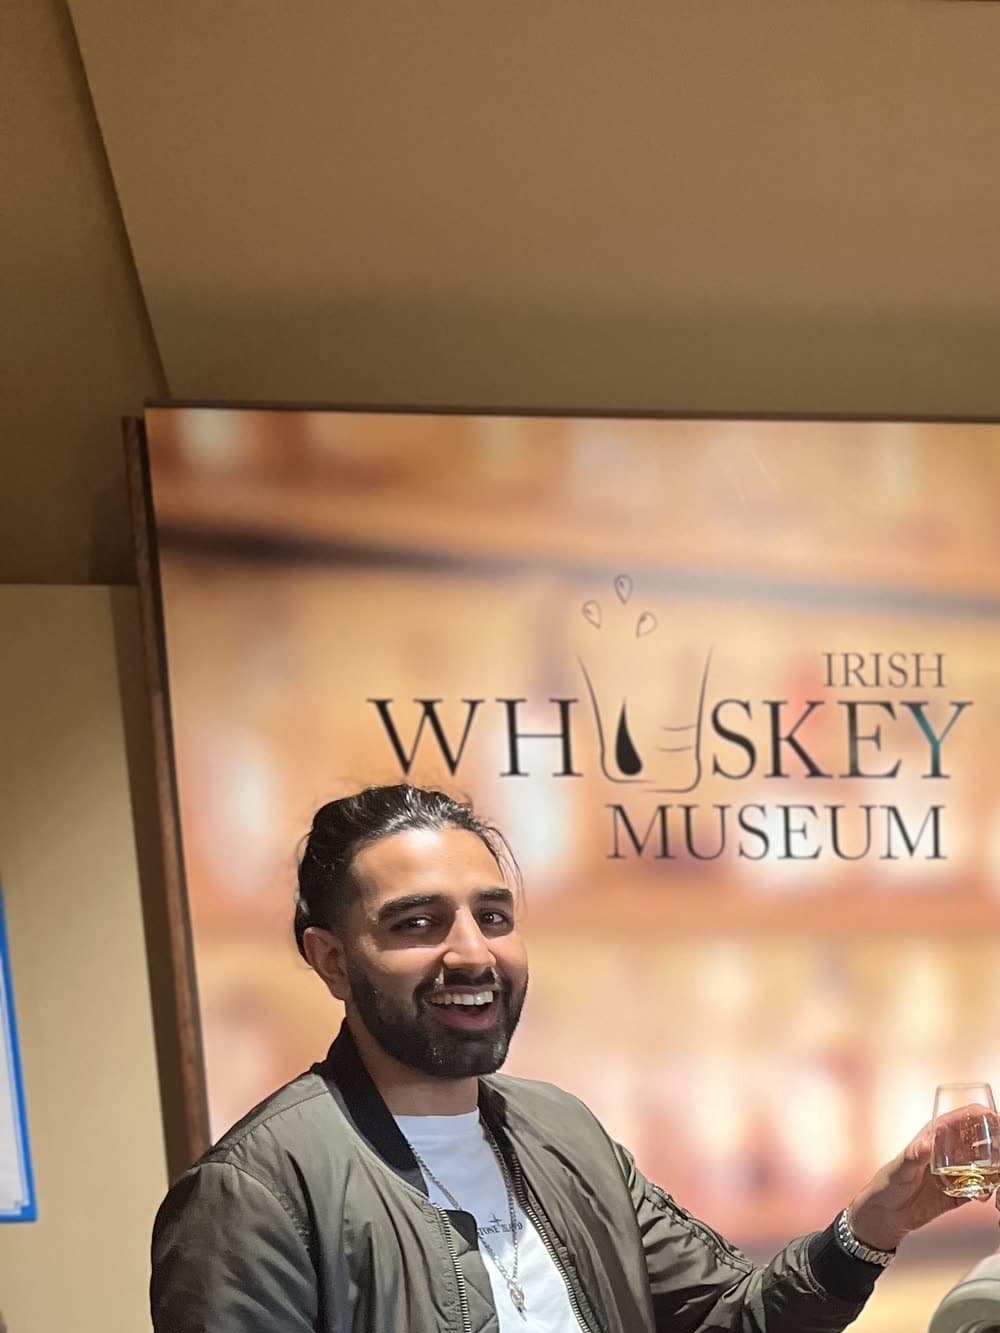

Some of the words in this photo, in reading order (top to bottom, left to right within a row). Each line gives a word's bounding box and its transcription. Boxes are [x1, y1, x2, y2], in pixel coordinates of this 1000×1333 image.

[822, 652, 947, 688] IRISH
[366, 697, 974, 781] WHISKEY
[604, 804, 947, 860] MUSEUM
